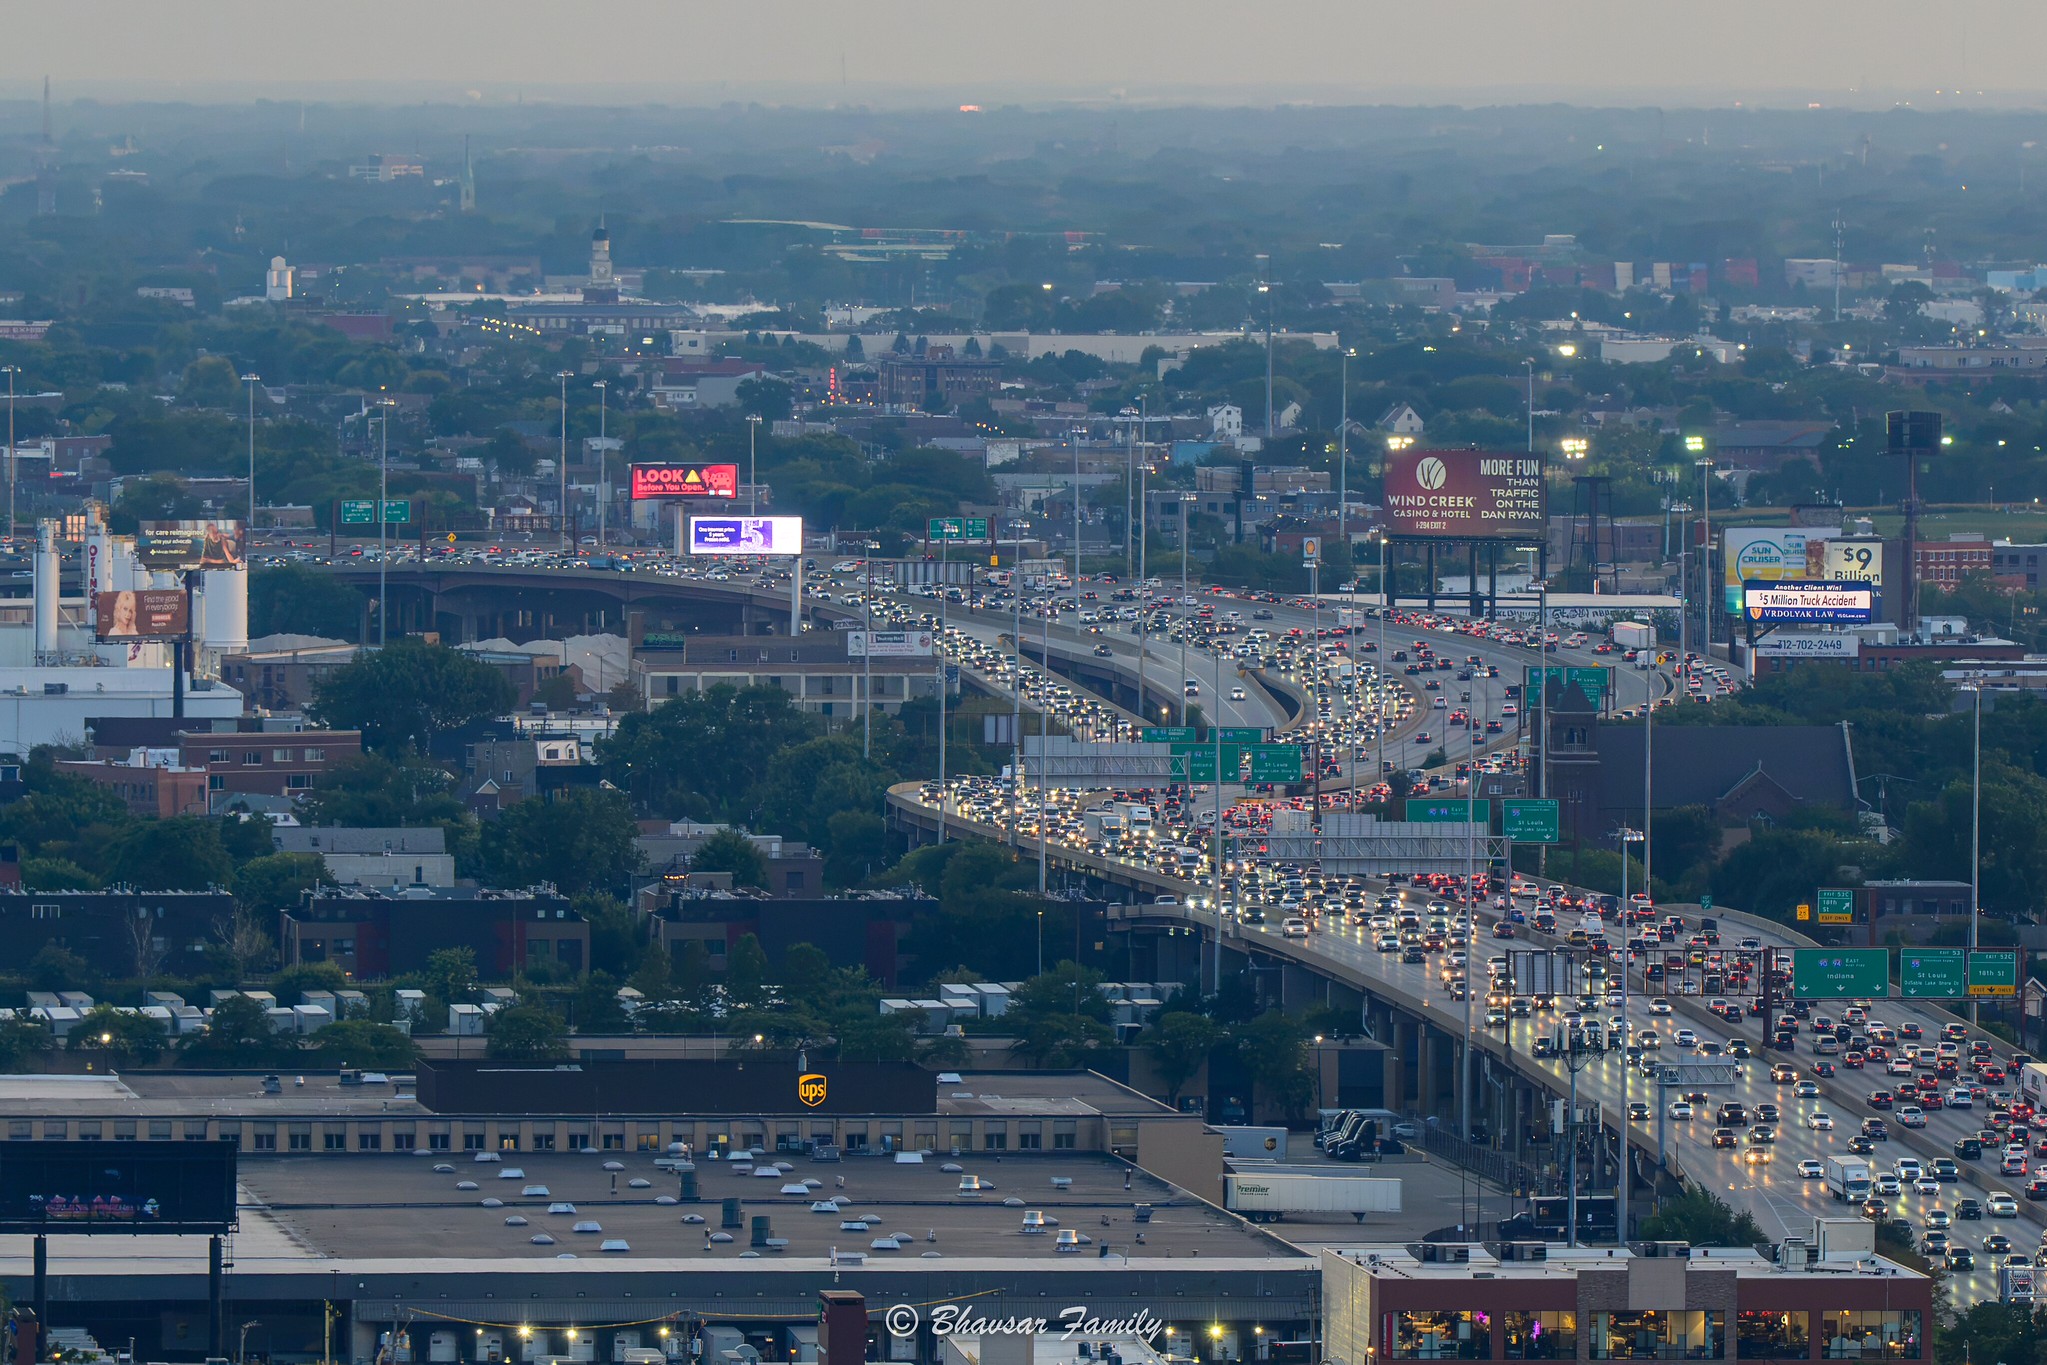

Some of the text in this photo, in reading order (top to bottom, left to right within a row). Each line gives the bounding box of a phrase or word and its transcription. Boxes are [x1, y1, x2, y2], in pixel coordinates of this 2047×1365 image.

[1480, 459, 1539, 476] MORE FUN
[636, 469, 684, 482] LOOK
[1506, 478, 1539, 486] THAN
[681, 484, 704, 492] Open.
[1490, 489, 1539, 498] TRAFFIC
[1388, 494, 1426, 506] WIND
[1496, 500, 1540, 508] ON THE
[1393, 510, 1470, 518] CASINO & HOTEL
[1481, 510, 1542, 520] DAN RYAN.
[1416, 522, 1446, 530] I-294 EXIT 2
[170, 528, 204, 537] reimagined
[1742, 556, 1780, 564] CRUISER
[1844, 546, 1872, 570] $9
[1834, 570, 1880, 582] Billion
[1760, 593, 1856, 606] $5 Million Truck Accident
[1764, 610, 1812, 618] VRDOLYAK
[1778, 640, 1842, 649] 312-702-2449
[802, 1084, 824, 1101] ups
[1237, 1184, 1270, 1193] Premier
